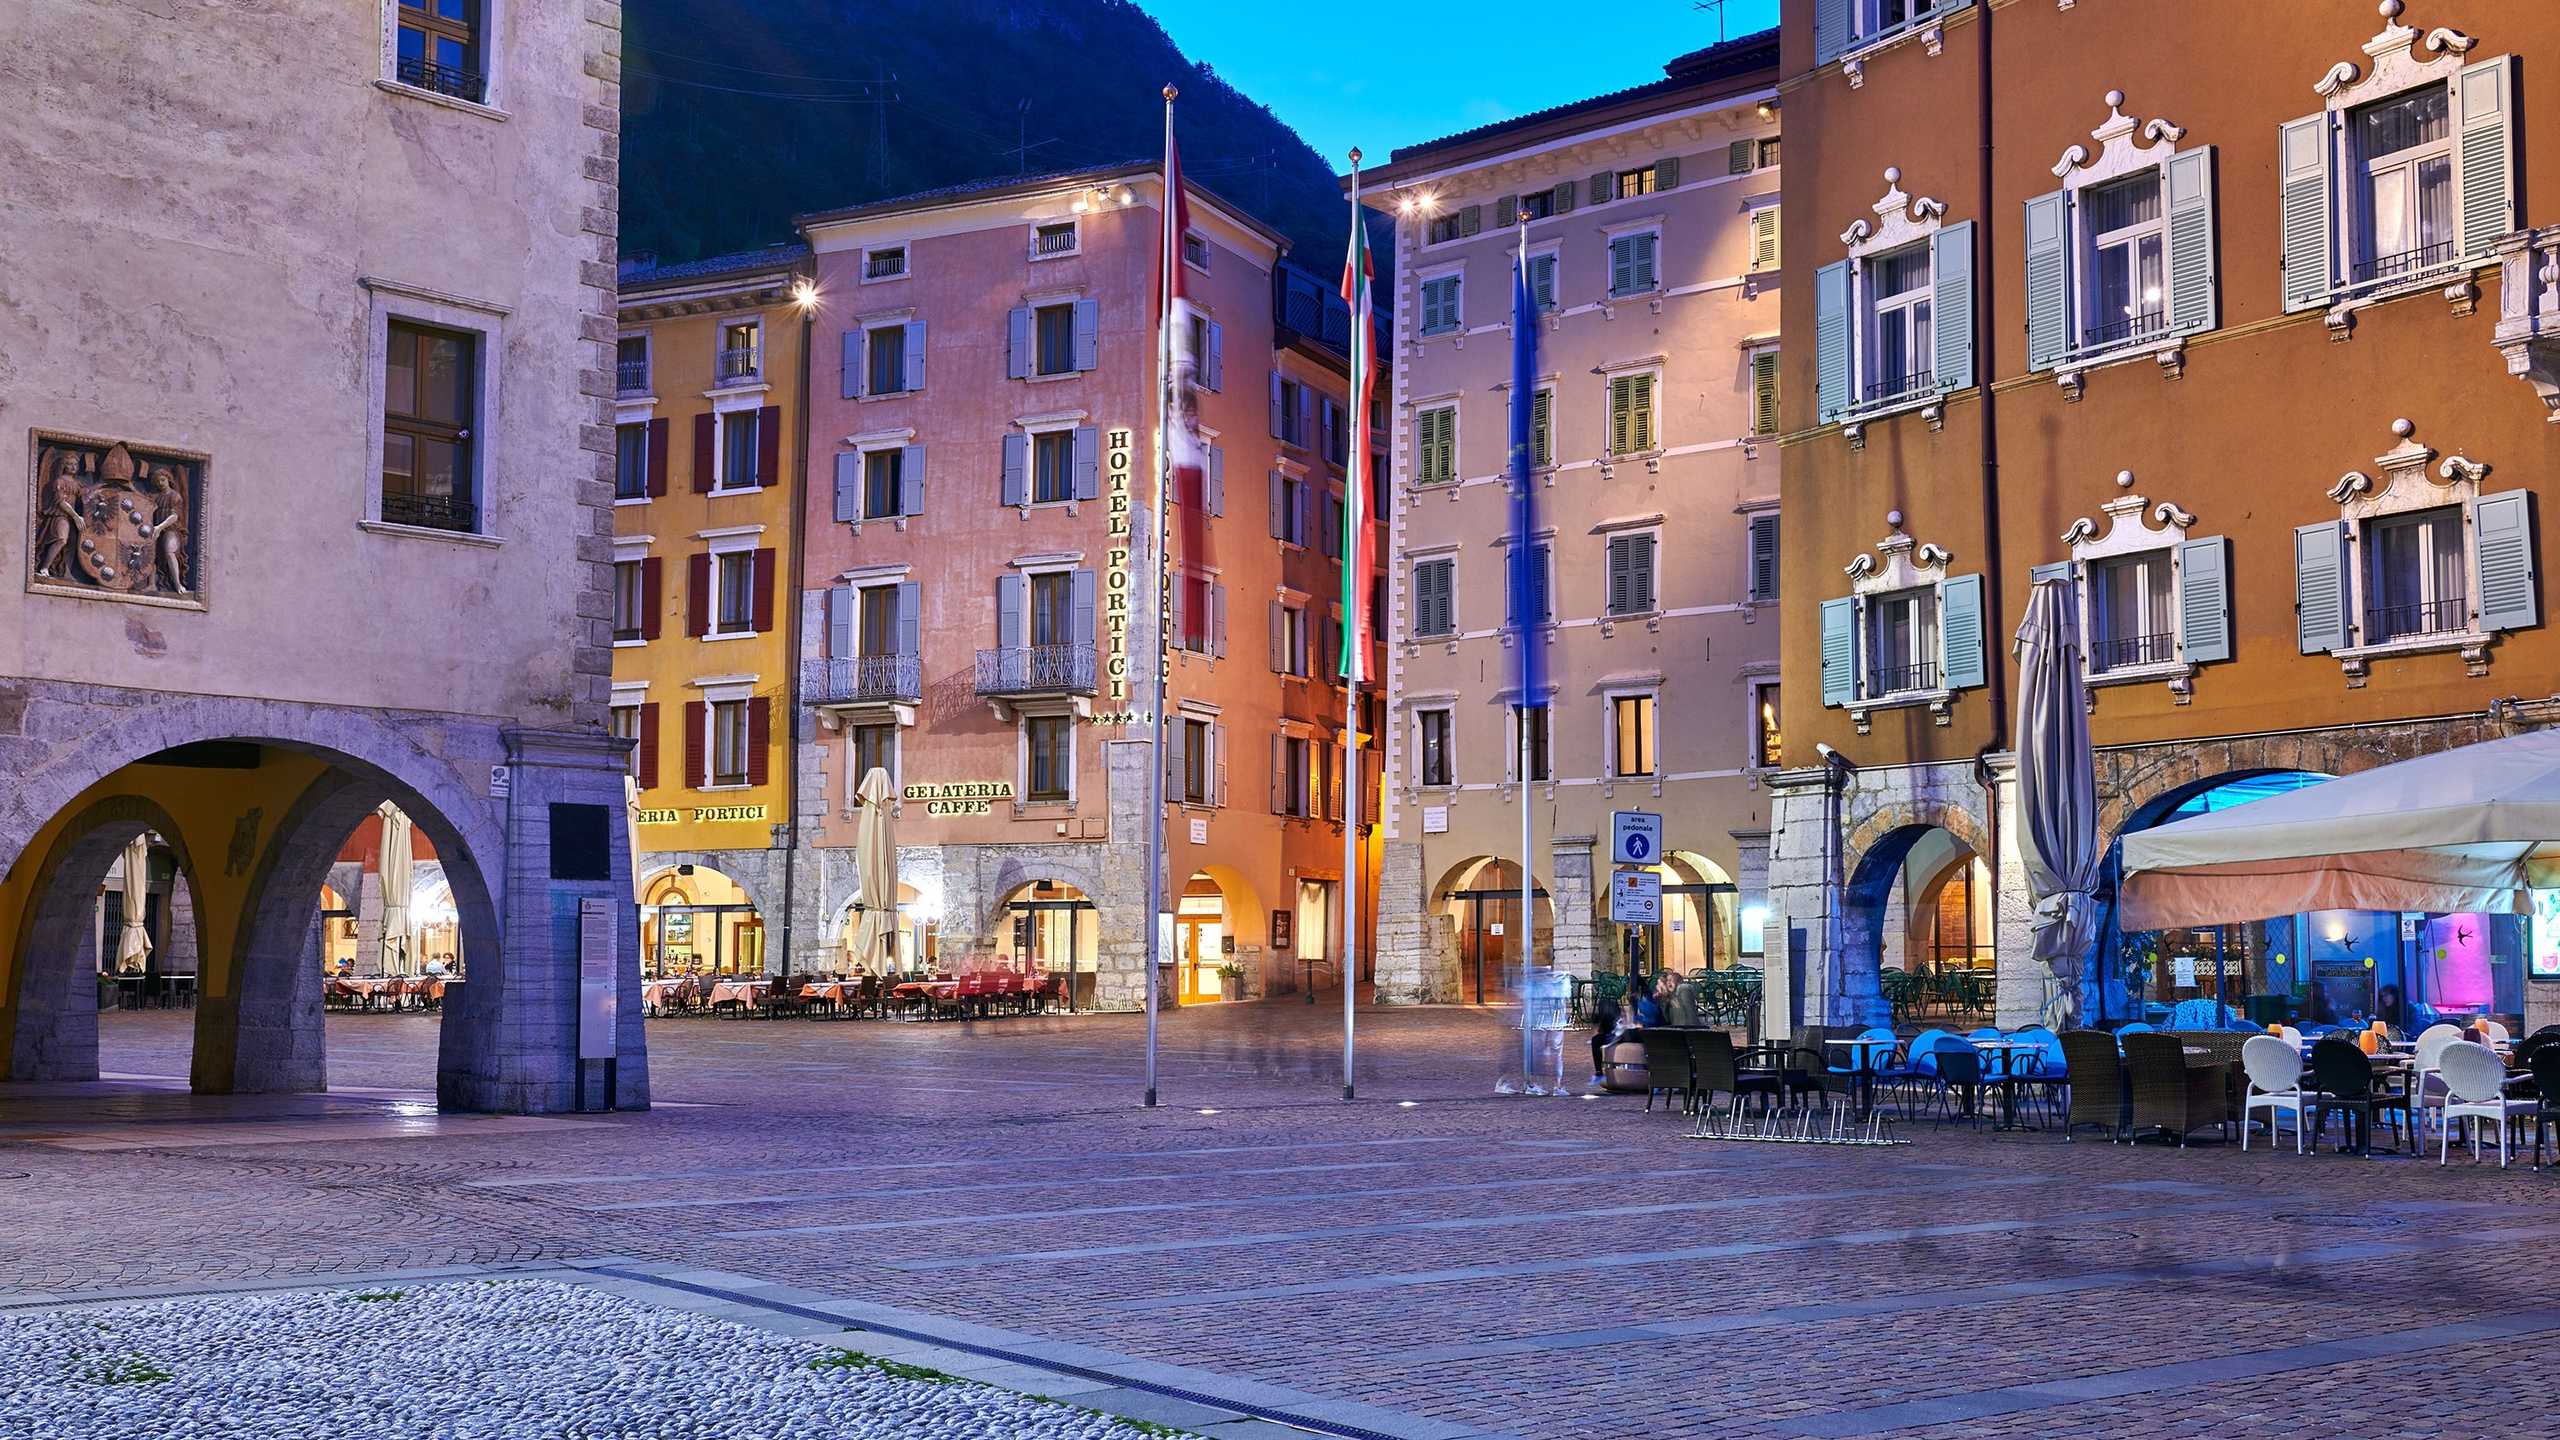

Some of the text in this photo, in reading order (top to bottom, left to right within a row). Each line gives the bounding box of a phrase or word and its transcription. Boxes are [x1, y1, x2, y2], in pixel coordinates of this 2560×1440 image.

[1107, 431, 1129, 698] HOTEL PORTICI
[903, 783, 1012, 799] GELATERIA
[637, 806, 764, 822] ERIA PORTICI
[1622, 824, 1653, 832] pedonale
